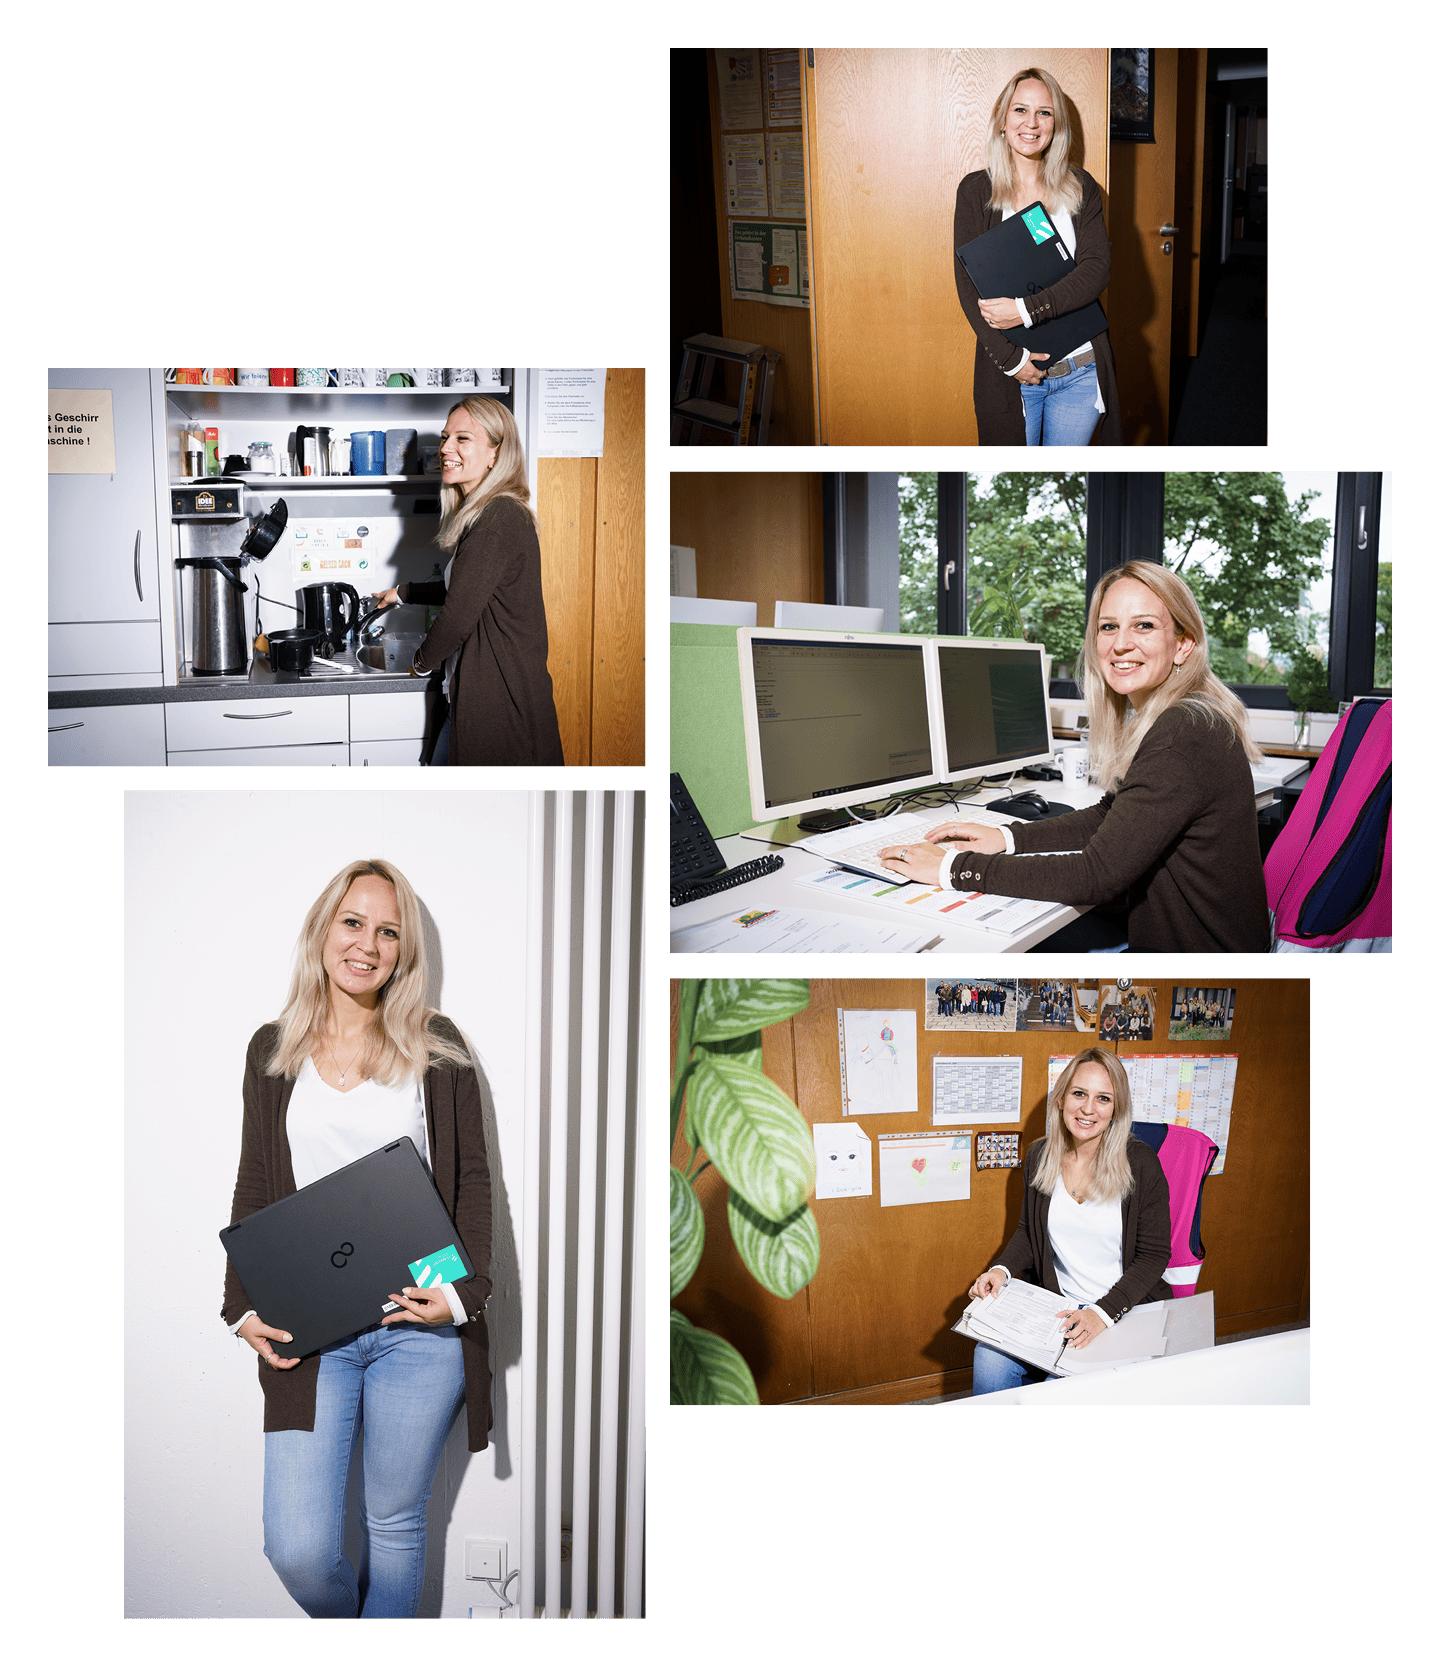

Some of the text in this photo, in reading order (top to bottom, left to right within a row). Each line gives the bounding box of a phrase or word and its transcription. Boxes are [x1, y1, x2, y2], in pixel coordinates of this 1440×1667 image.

[54, 413, 99, 422] Geschirr
[54, 425, 64, 433] in
[67, 425, 83, 433] die
